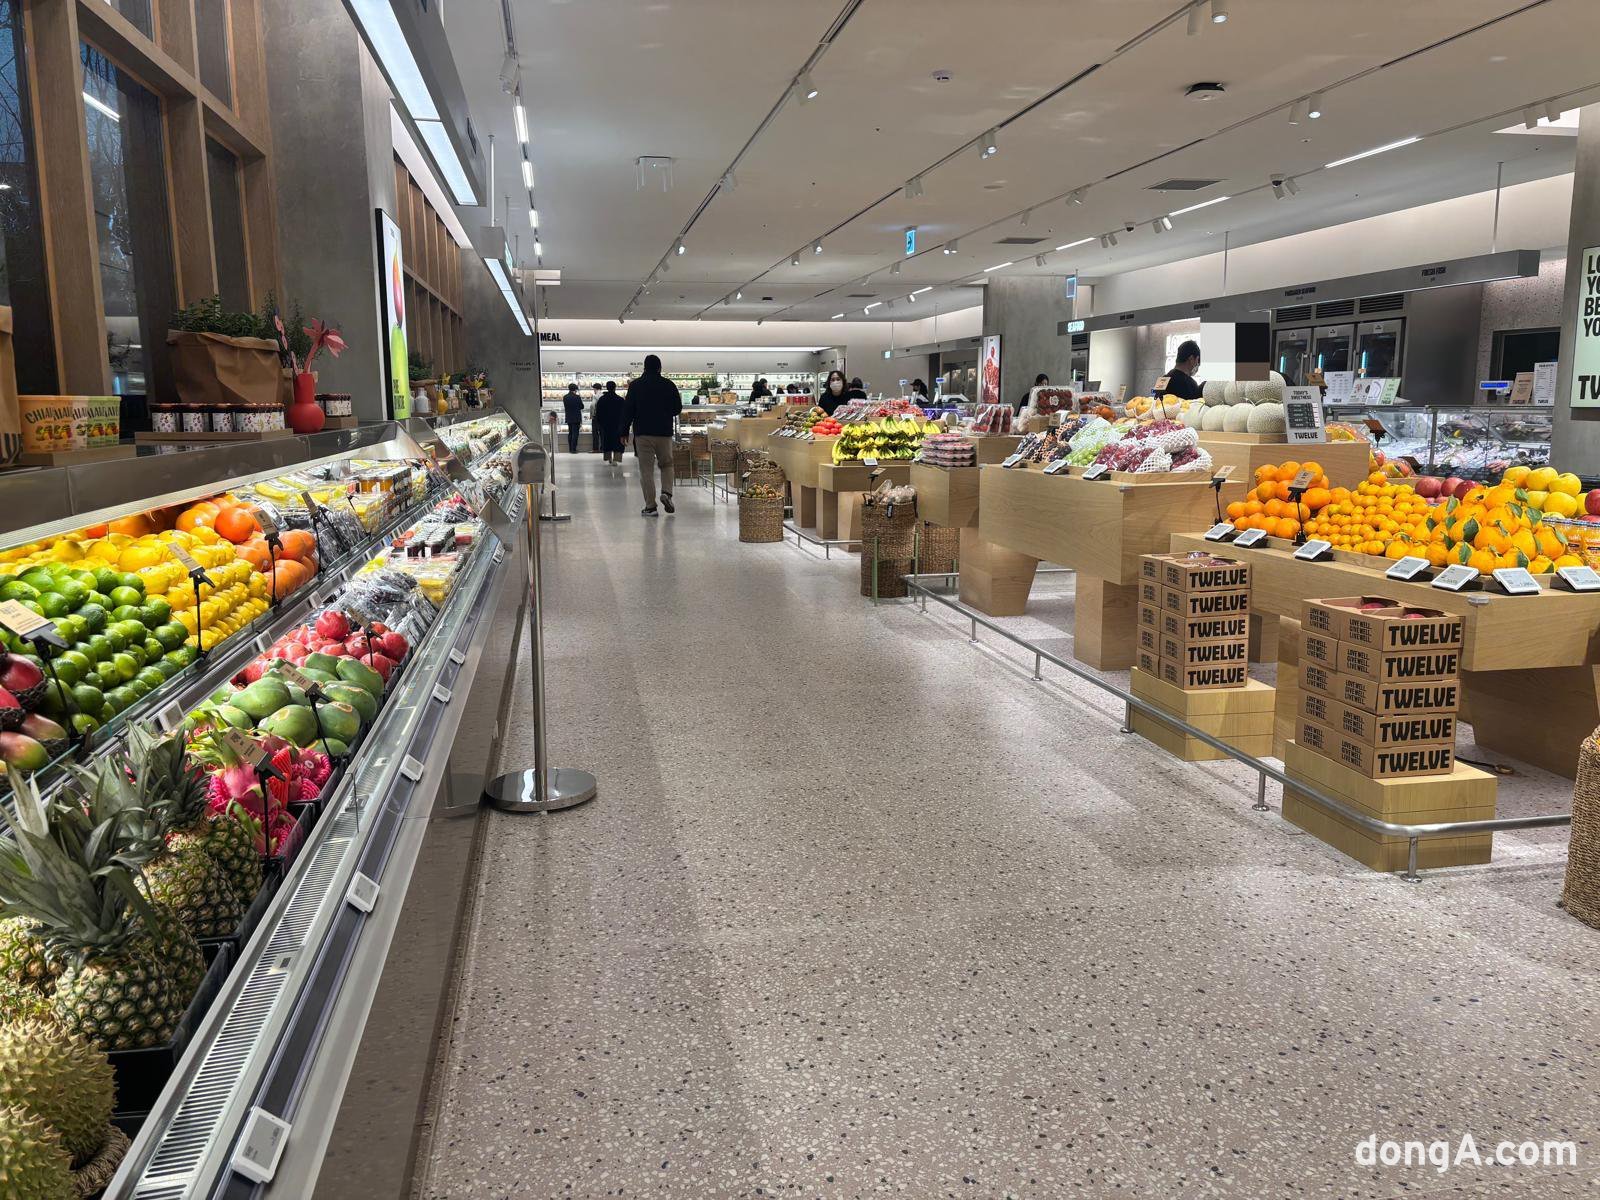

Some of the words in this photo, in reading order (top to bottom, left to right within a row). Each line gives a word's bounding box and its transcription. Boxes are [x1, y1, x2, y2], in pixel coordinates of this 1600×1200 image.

[1068, 320, 1084, 332] SEAFOOD
[540, 332, 561, 342] MEAL
[1190, 569, 1247, 588] TWELVE
[1190, 594, 1247, 613] TWELVE
[1188, 620, 1245, 638] TWELVE
[1389, 623, 1461, 646] TWELVE
[1188, 644, 1244, 662] TWELVE
[1385, 655, 1457, 677] TWELVE
[1188, 668, 1244, 686] TWELVE
[1383, 687, 1456, 709] TWELVE
[1380, 718, 1451, 742] TWELVE
[1378, 750, 1450, 773] TWELVE
